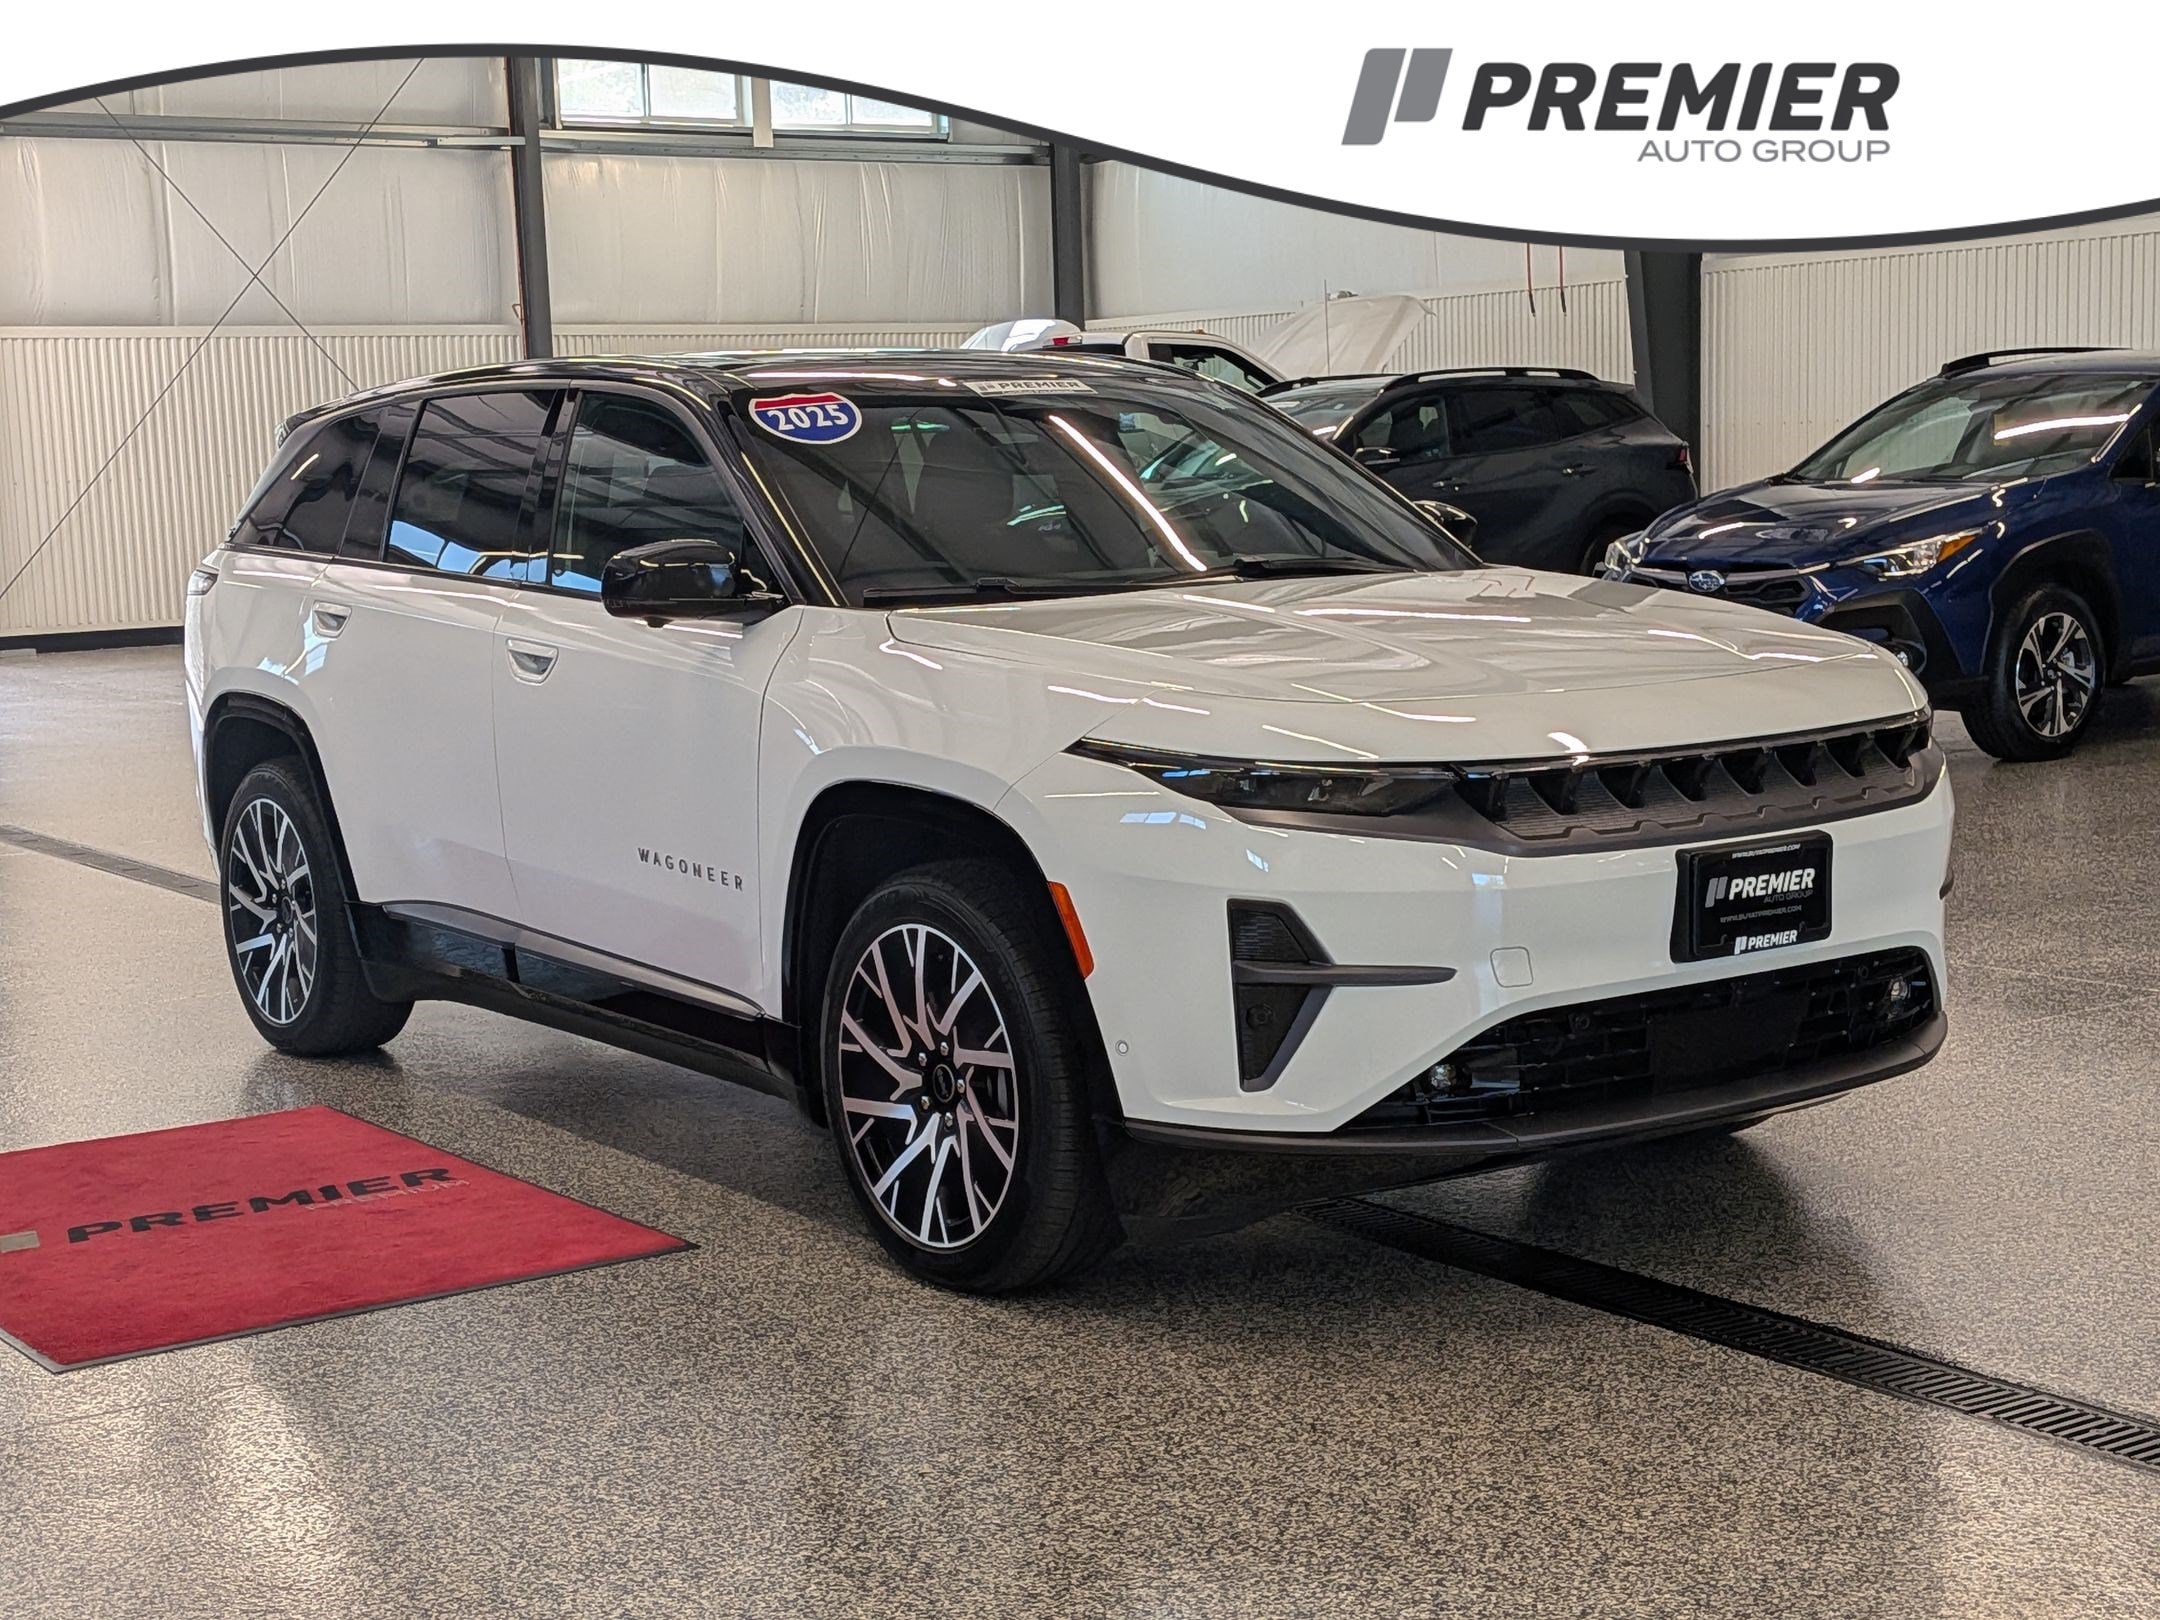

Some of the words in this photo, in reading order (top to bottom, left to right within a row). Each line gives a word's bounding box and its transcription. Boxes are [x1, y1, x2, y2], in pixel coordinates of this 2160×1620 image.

[997, 380, 1081, 390] PREMIER
[767, 404, 849, 431] 2025
[638, 847, 743, 891] WAGONEER
[1728, 868, 1816, 901] PREMIER
[1763, 893, 1785, 904] AUTO
[1785, 889, 1814, 901] GROUP
[1747, 929, 1798, 951] PREMIER
[67, 1168, 457, 1243] PREMIER
